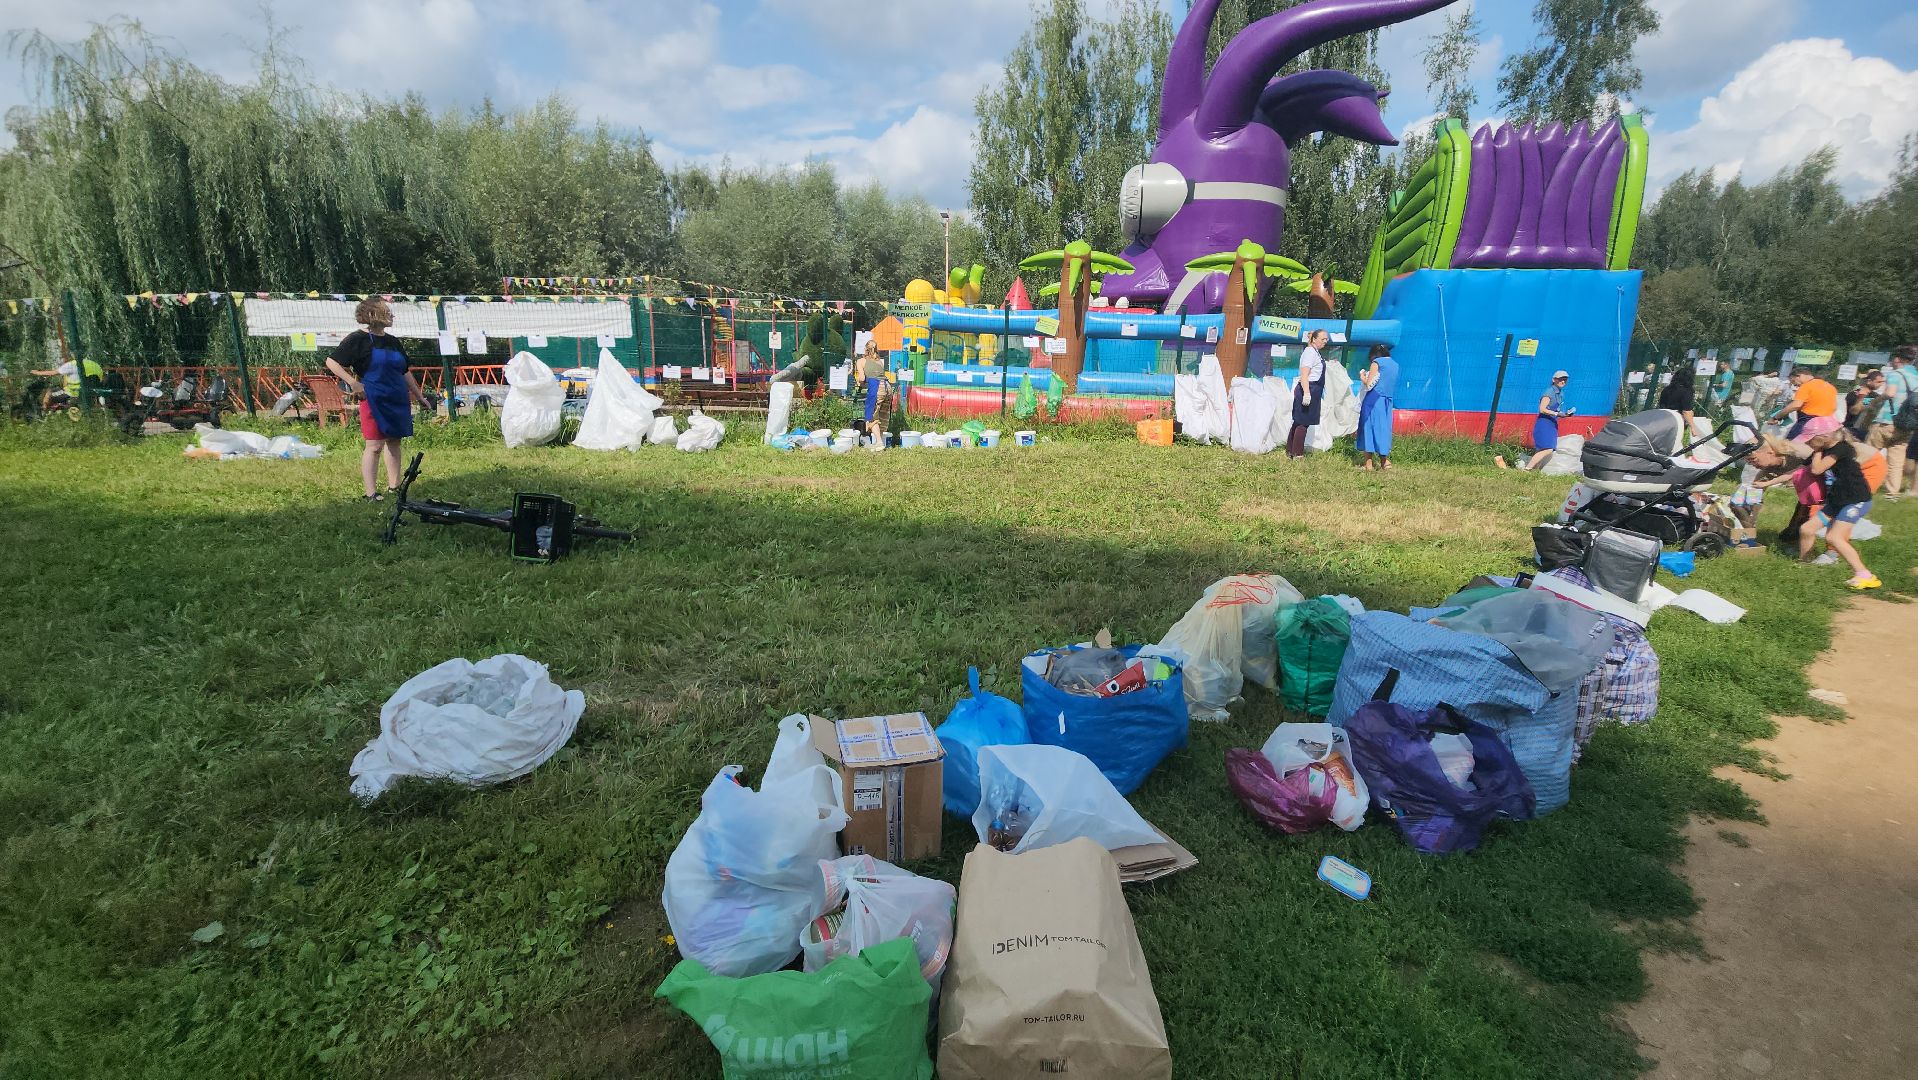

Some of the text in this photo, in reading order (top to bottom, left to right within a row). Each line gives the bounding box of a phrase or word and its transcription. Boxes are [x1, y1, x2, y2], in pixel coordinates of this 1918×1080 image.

[1262, 320, 1298, 332] МЕТАЛЛ
[992, 934, 1049, 955] DENIM
[1023, 1013, 1085, 1024] TOM-TAILOR.RU
